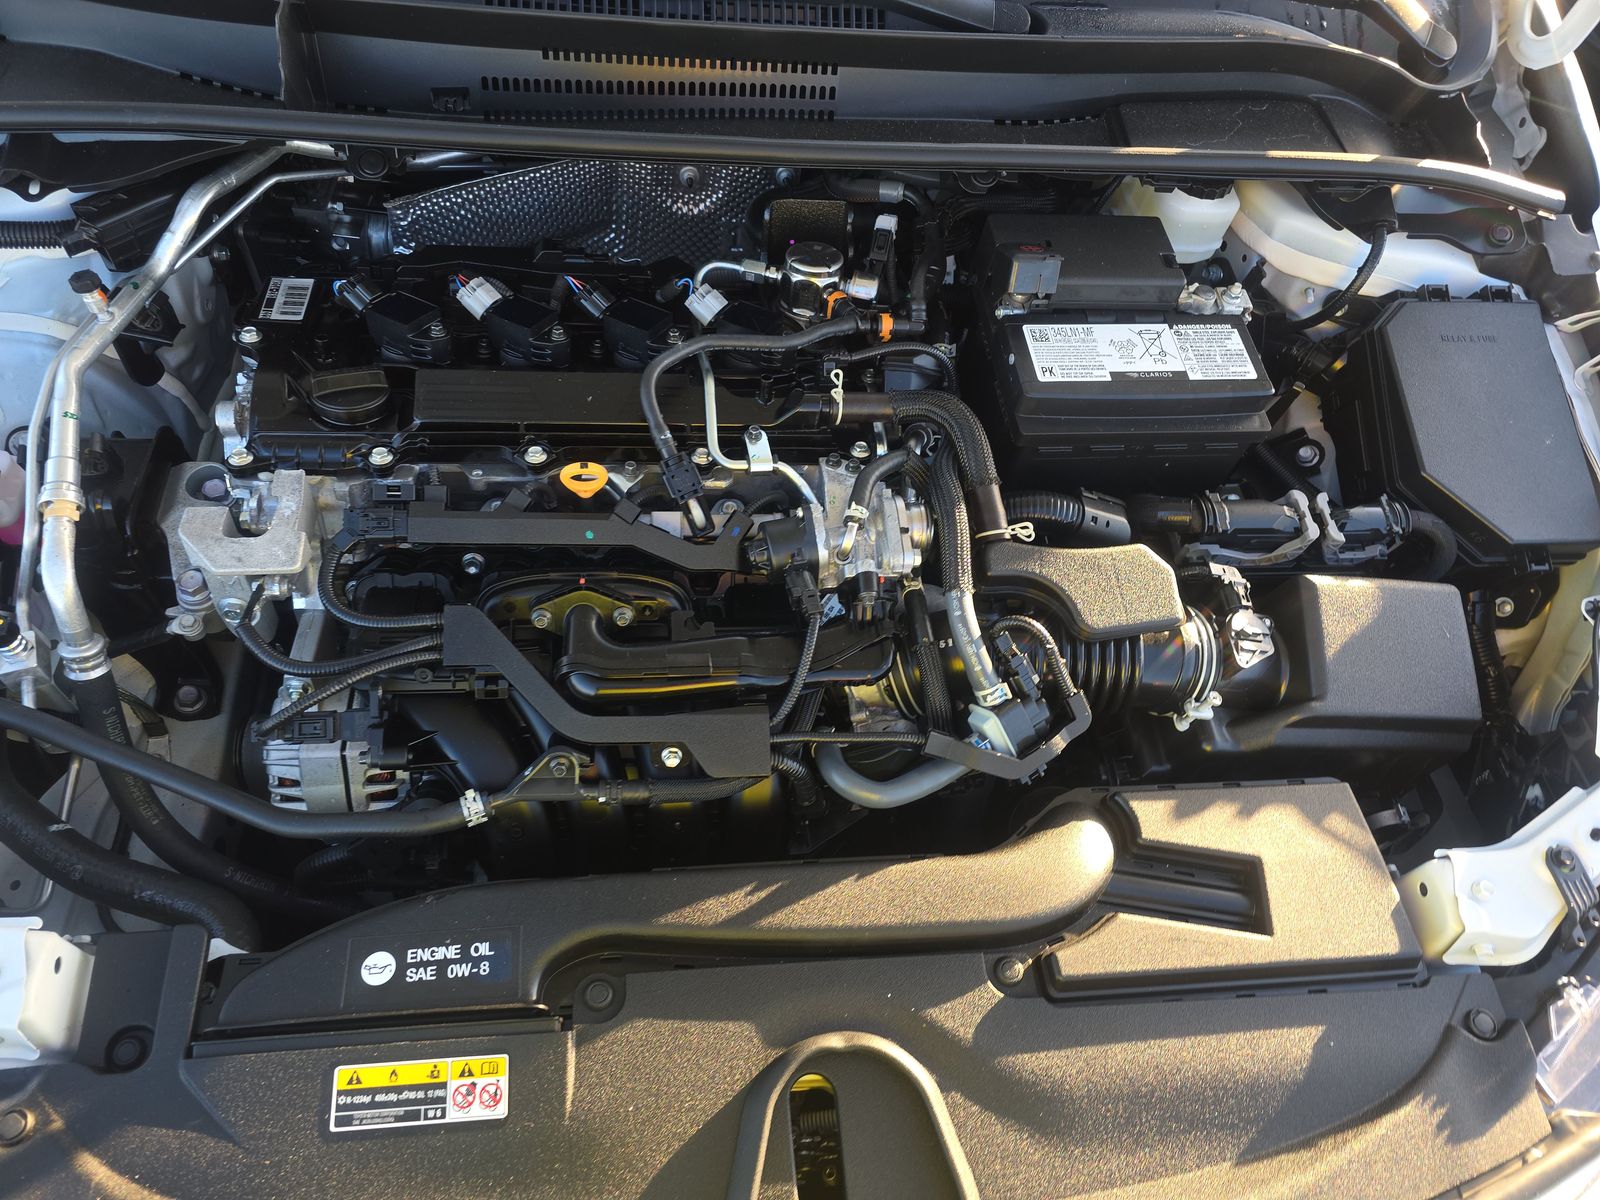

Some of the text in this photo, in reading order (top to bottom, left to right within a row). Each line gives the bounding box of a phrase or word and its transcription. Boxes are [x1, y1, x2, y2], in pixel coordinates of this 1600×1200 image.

[1050, 327, 1095, 337] 345LN1-MF
[1041, 366, 1056, 377] PK
[406, 941, 495, 963] ENGINE OIL
[405, 961, 490, 983] SAE 0W-8
